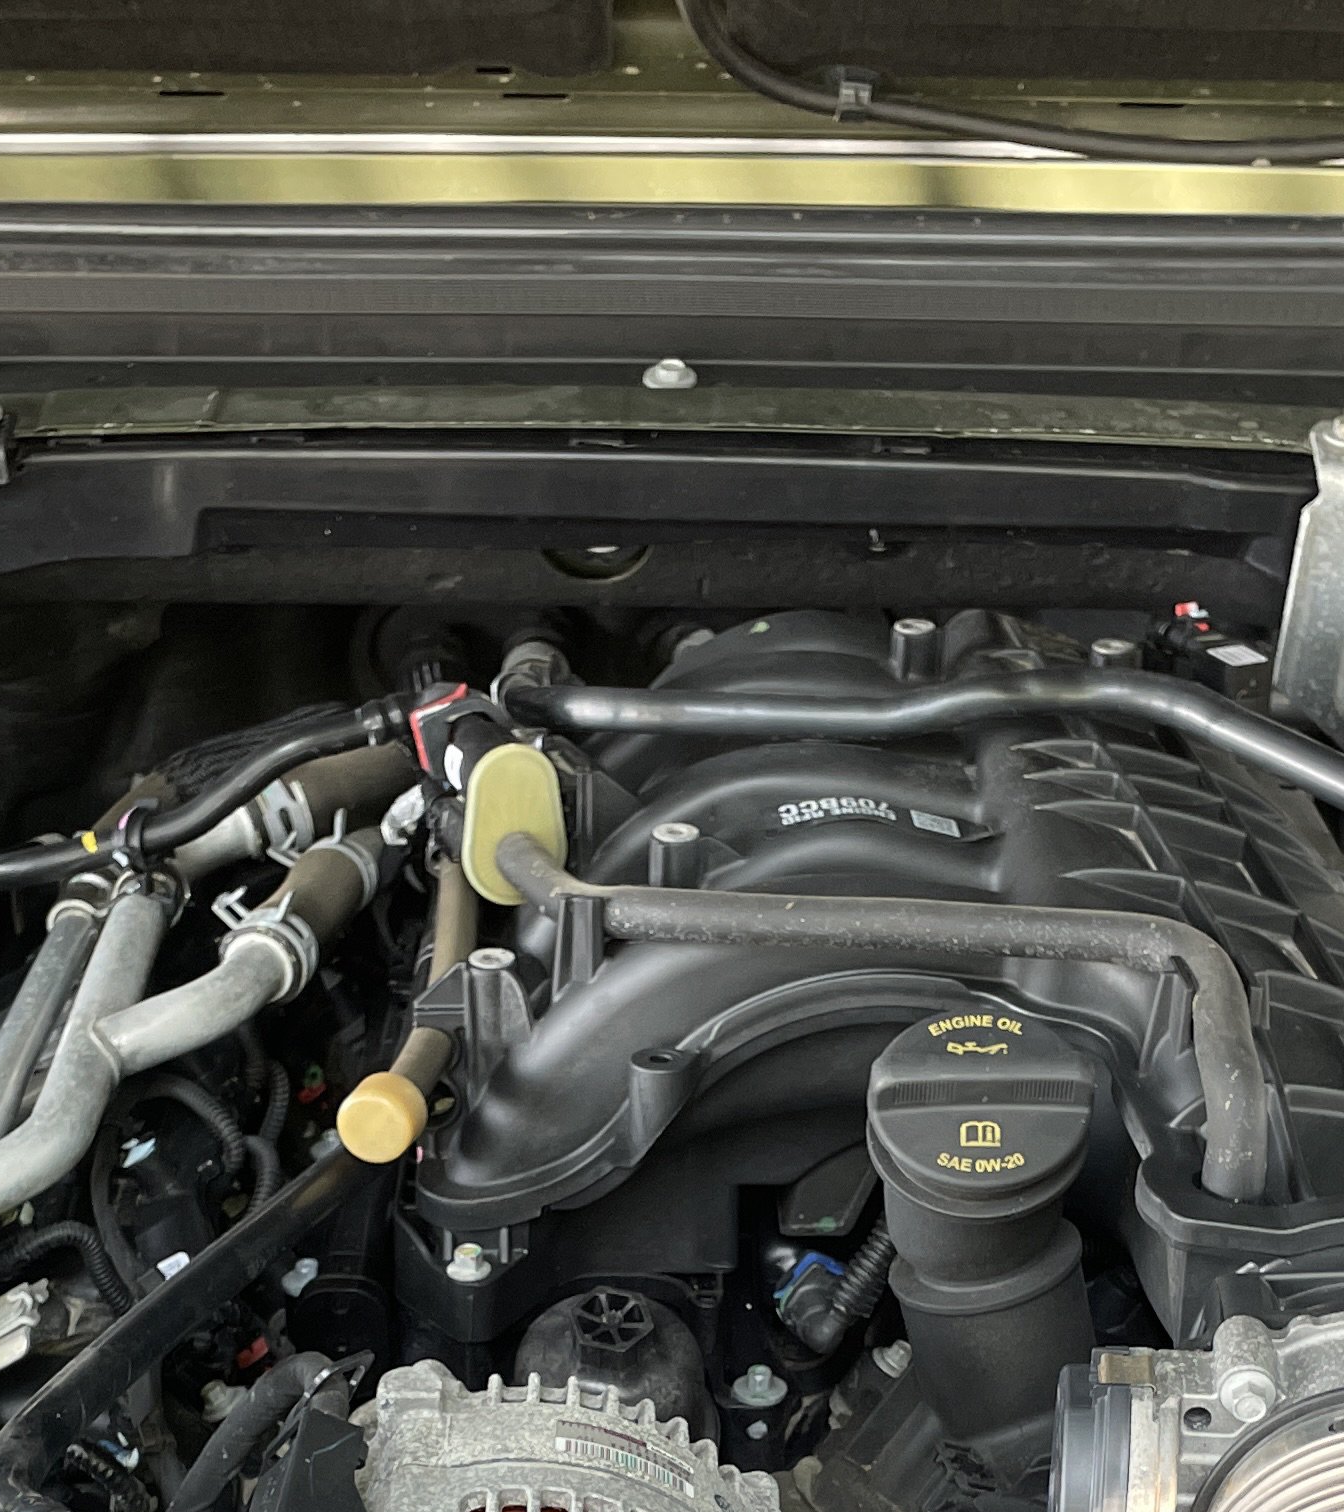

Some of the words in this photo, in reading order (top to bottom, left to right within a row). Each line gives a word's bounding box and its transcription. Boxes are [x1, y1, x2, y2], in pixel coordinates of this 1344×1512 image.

[927, 1014, 994, 1037] ENGINE
[996, 1017, 1023, 1036] OIL
[936, 1152, 973, 1173] SAE
[974, 1152, 1025, 1173] 0W-20
